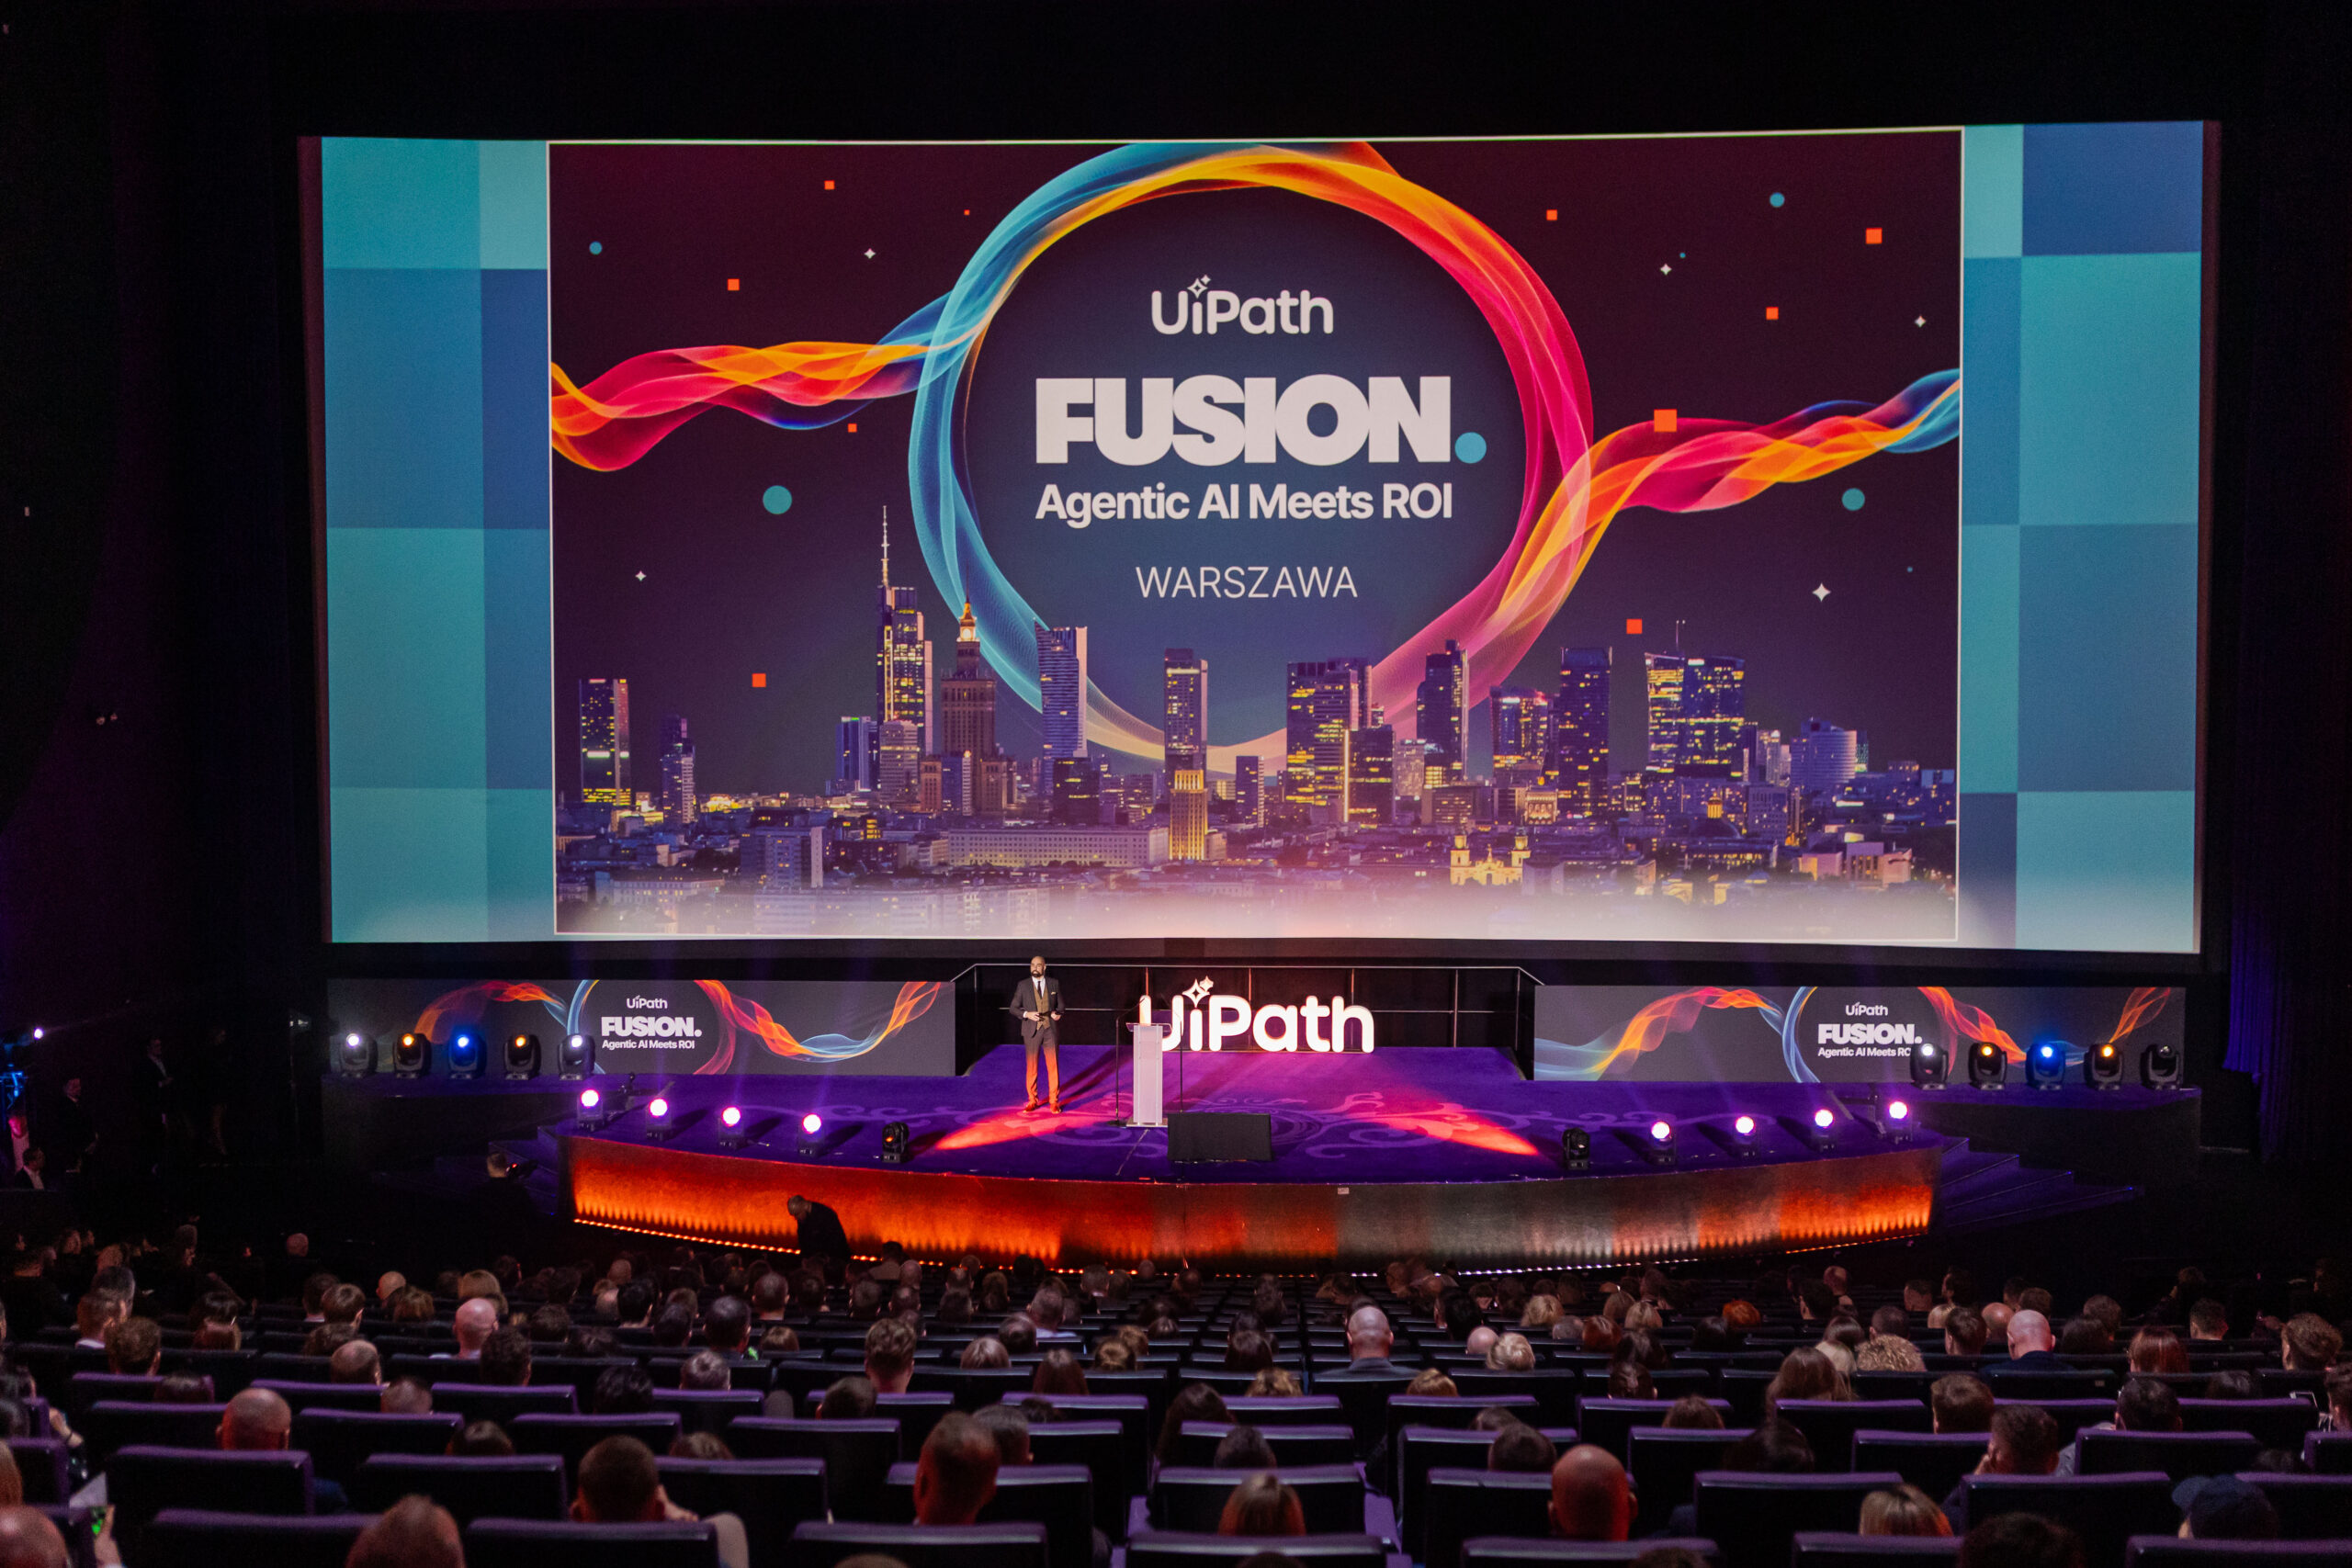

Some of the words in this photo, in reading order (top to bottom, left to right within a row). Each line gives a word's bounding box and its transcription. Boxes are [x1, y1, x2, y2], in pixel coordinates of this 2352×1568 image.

[1151, 275, 1334, 334] UiPath
[1035, 374, 1487, 466] FUSION.
[1035, 482, 1190, 529] Agentic
[1197, 484, 1239, 519] AI
[1250, 483, 1374, 519] Meets
[1383, 482, 1453, 519] ROI
[1136, 566, 1358, 599] WARSZAWA
[626, 995, 668, 1010] UiPath
[1845, 1002, 1888, 1016] UiPath
[1138, 976, 1374, 1053] UiPath
[601, 1016, 702, 1037] FUSION.
[1817, 1023, 1923, 1045] FUSION.
[602, 1039, 637, 1051] Agentic
[638, 1040, 648, 1049] AI
[649, 1040, 677, 1049] Meets
[678, 1040, 695, 1049] ROI
[1817, 1047, 1854, 1058] Agentic
[1855, 1047, 1866, 1056] AI
[1867, 1047, 1896, 1056] Meets
[1897, 1047, 1911, 1056] RO
